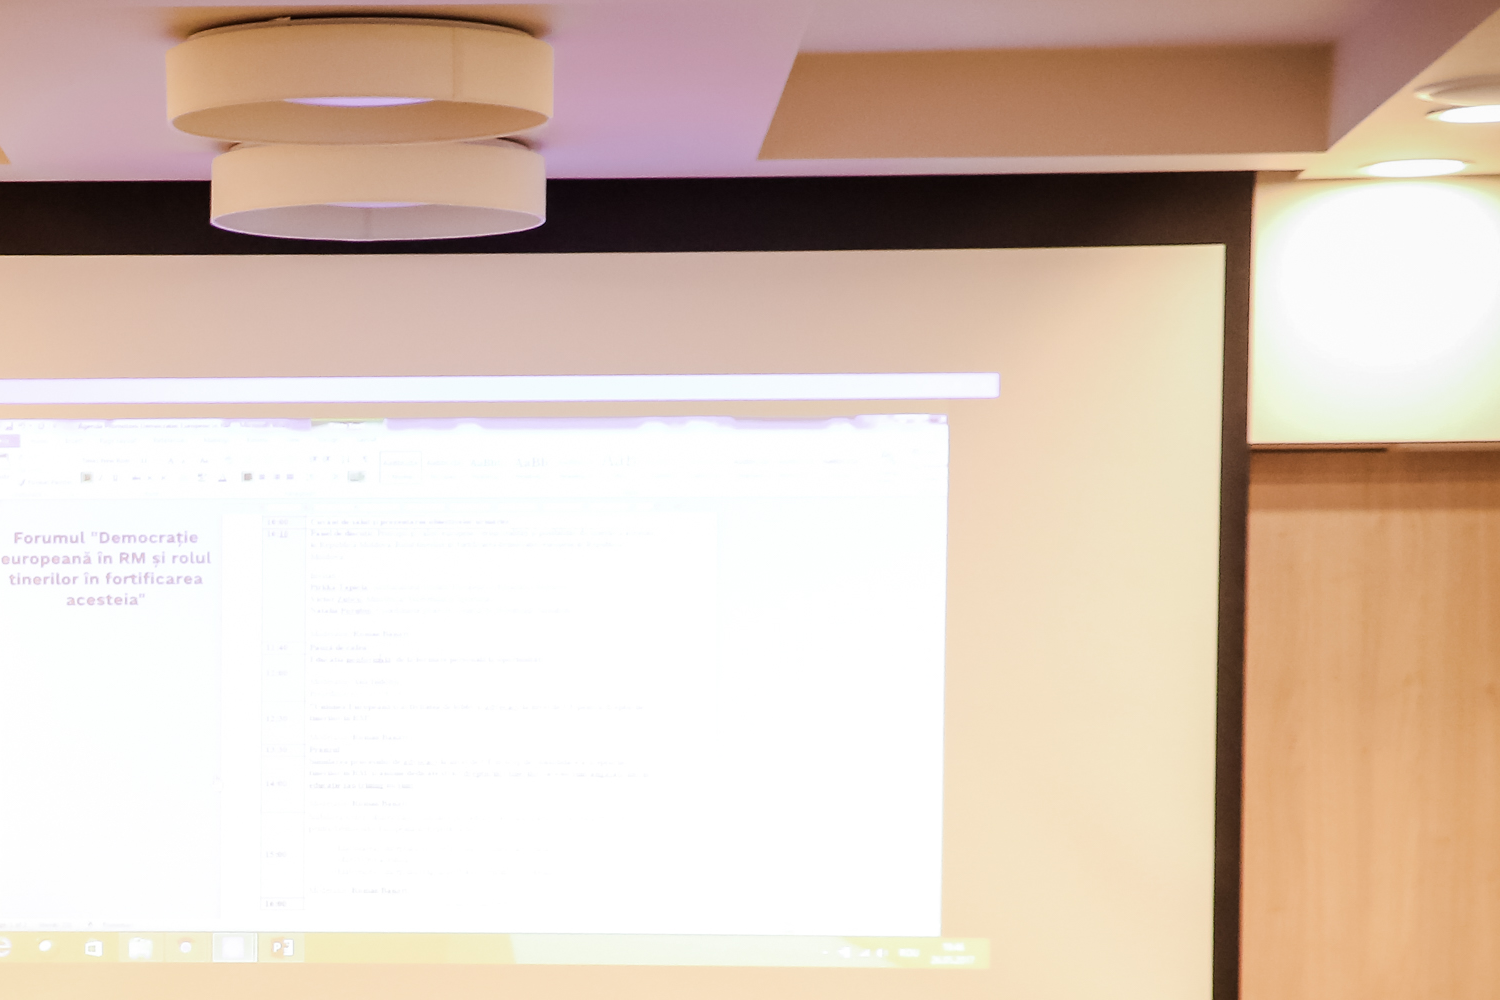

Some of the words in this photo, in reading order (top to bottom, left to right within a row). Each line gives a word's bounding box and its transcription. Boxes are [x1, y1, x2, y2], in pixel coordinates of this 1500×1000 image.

[13, 530, 85, 544] Forumul
[1, 551, 92, 568] europeană
[97, 551, 113, 564] în
[119, 552, 146, 564] RM
[172, 551, 211, 564] rolul
[83, 572, 100, 585] în
[105, 572, 204, 585] fortificarea
